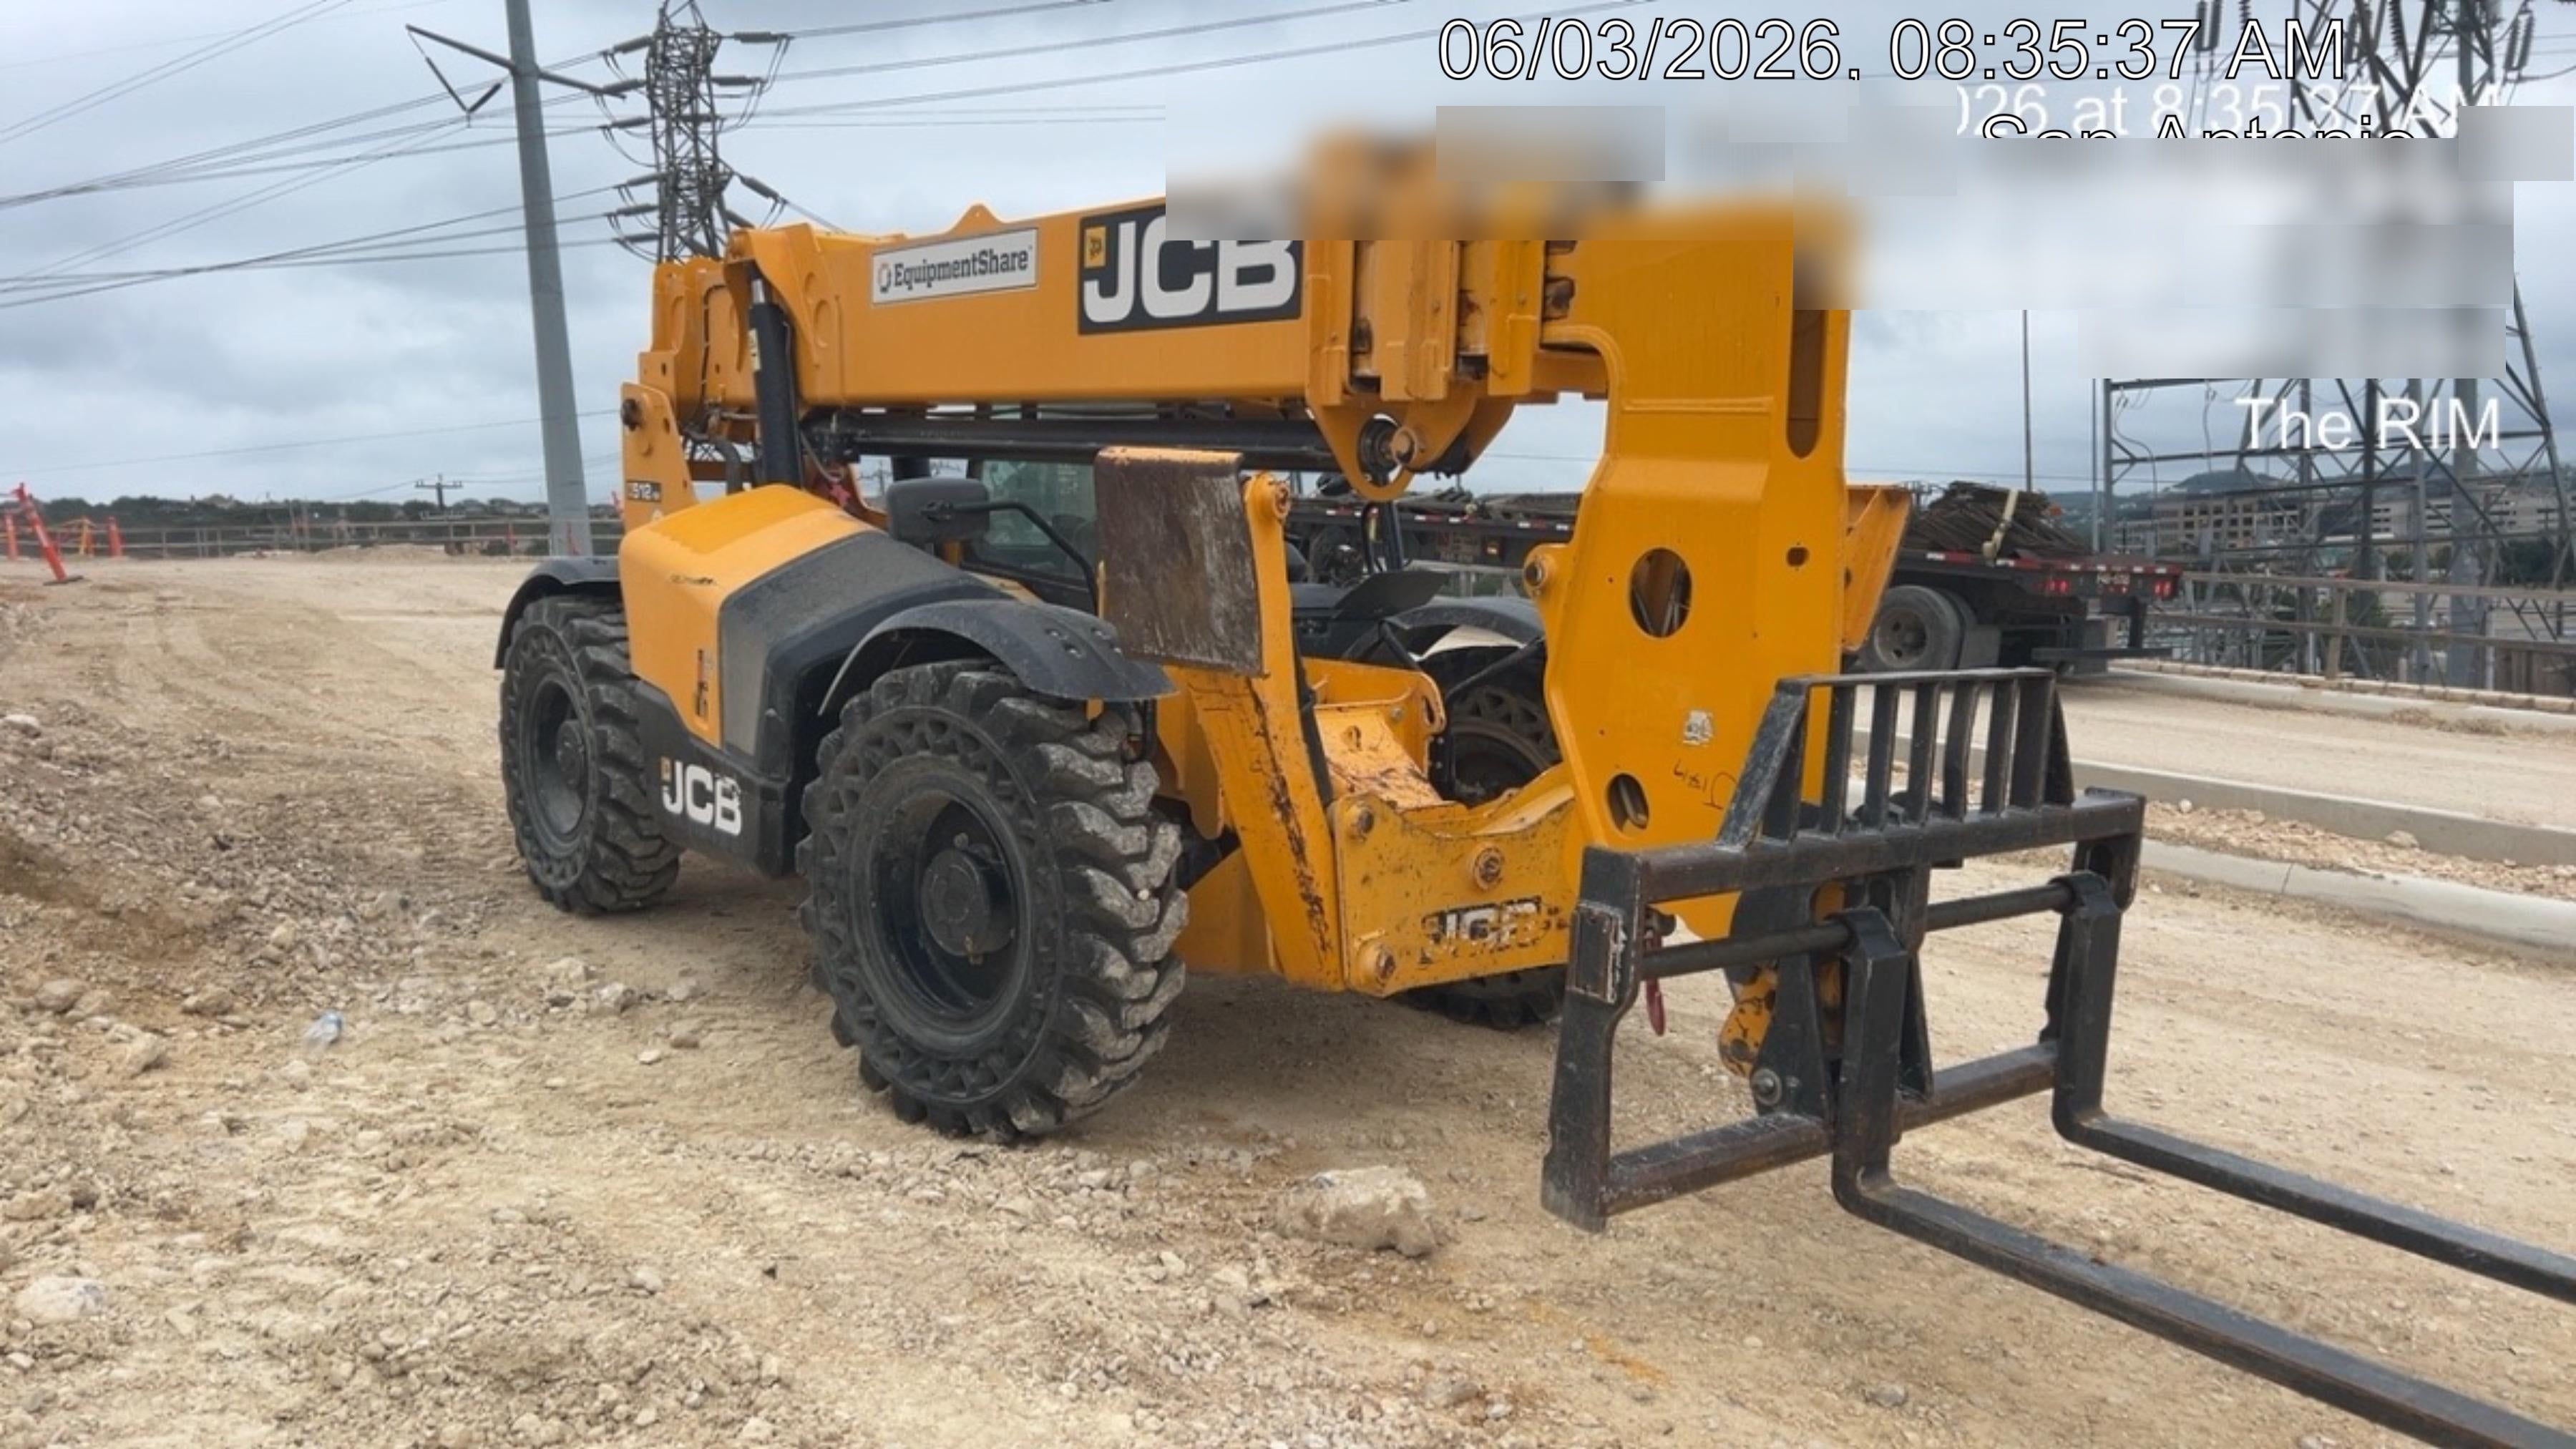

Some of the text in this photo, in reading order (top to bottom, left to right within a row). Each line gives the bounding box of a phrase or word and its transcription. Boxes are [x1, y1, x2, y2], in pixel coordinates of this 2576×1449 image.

[894, 248, 1028, 291] EquipmentShare
[1083, 215, 1296, 323] JCB
[663, 760, 741, 836] JCB
